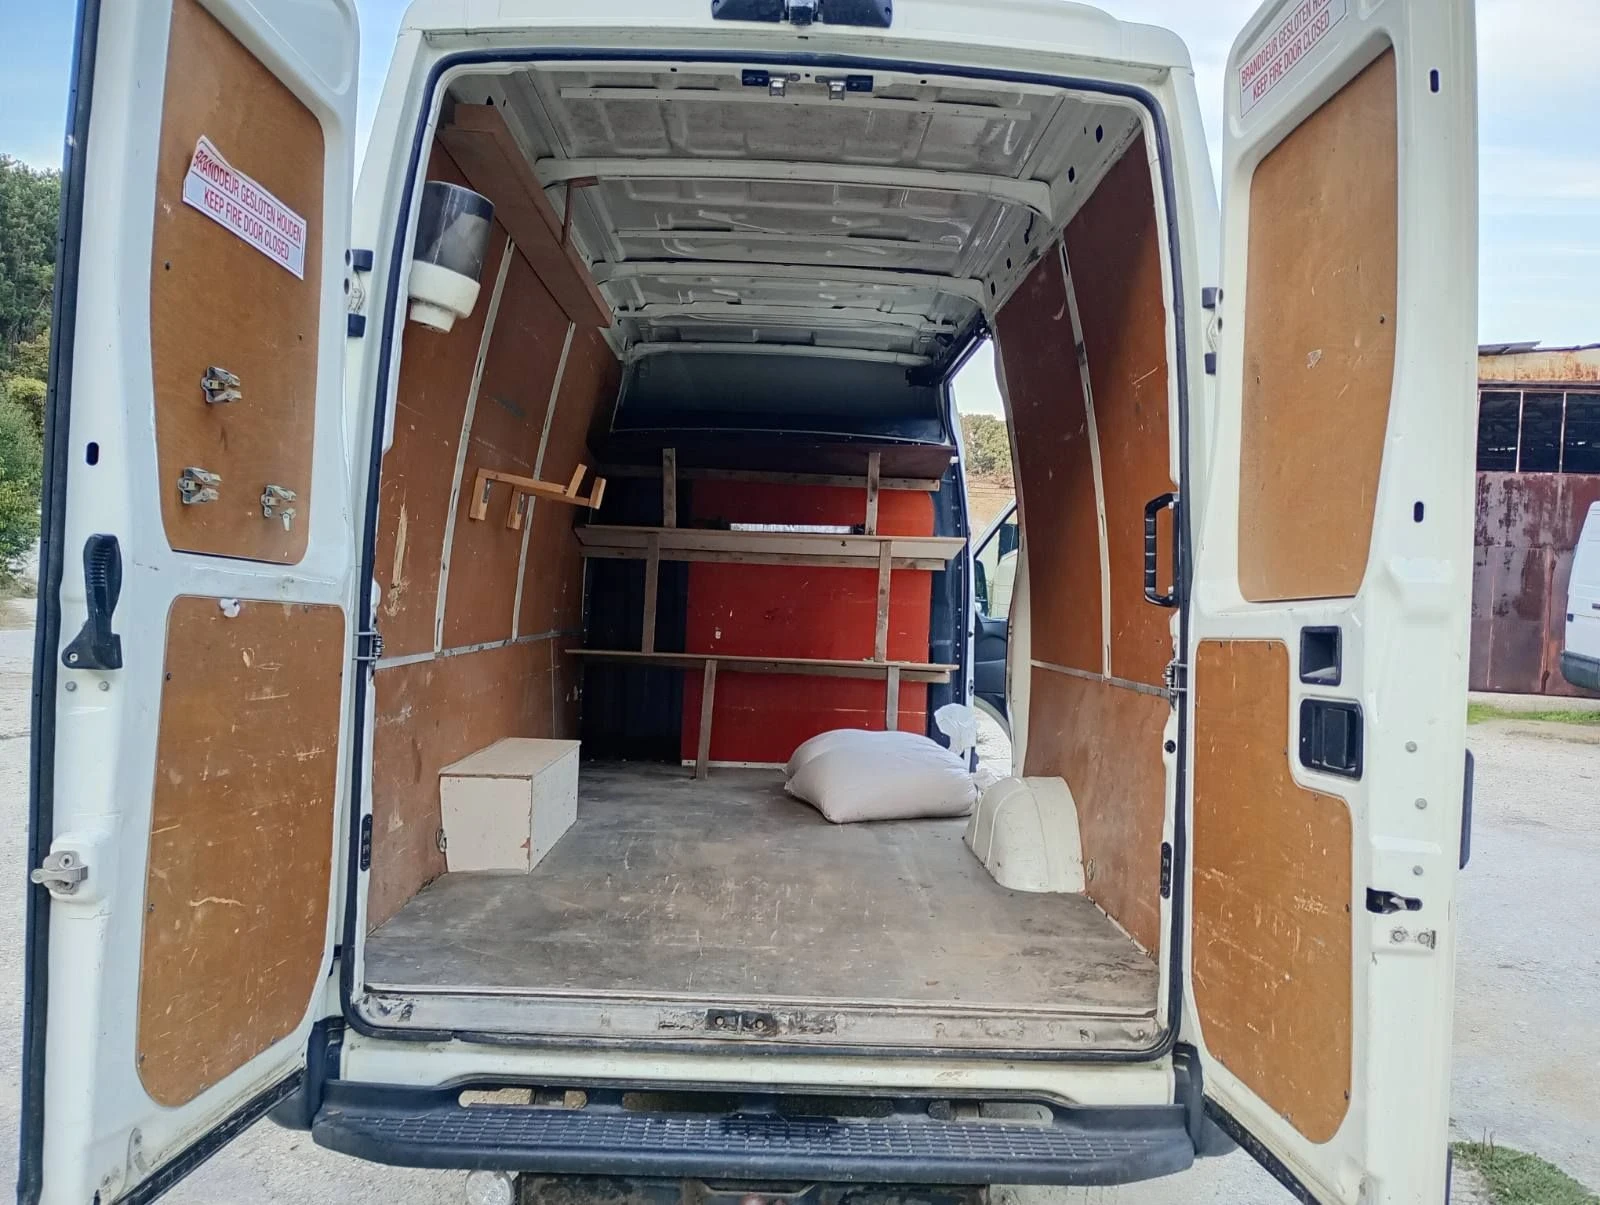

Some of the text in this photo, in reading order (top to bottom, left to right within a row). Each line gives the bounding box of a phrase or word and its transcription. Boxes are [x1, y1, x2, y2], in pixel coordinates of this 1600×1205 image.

[1241, 0, 1312, 87] BRANDDEUR GESLOTEN
[1253, 73, 1268, 101] KEEP
[1269, 58, 1283, 85] FIRE
[1284, 39, 1302, 70] DOOR
[1303, 9, 1330, 50] CLOSED
[193, 150, 302, 243] BRANDDEUR GESLOTEN HOUDEN
[204, 186, 290, 260] KEEP FIRE DOOR CLOSED
